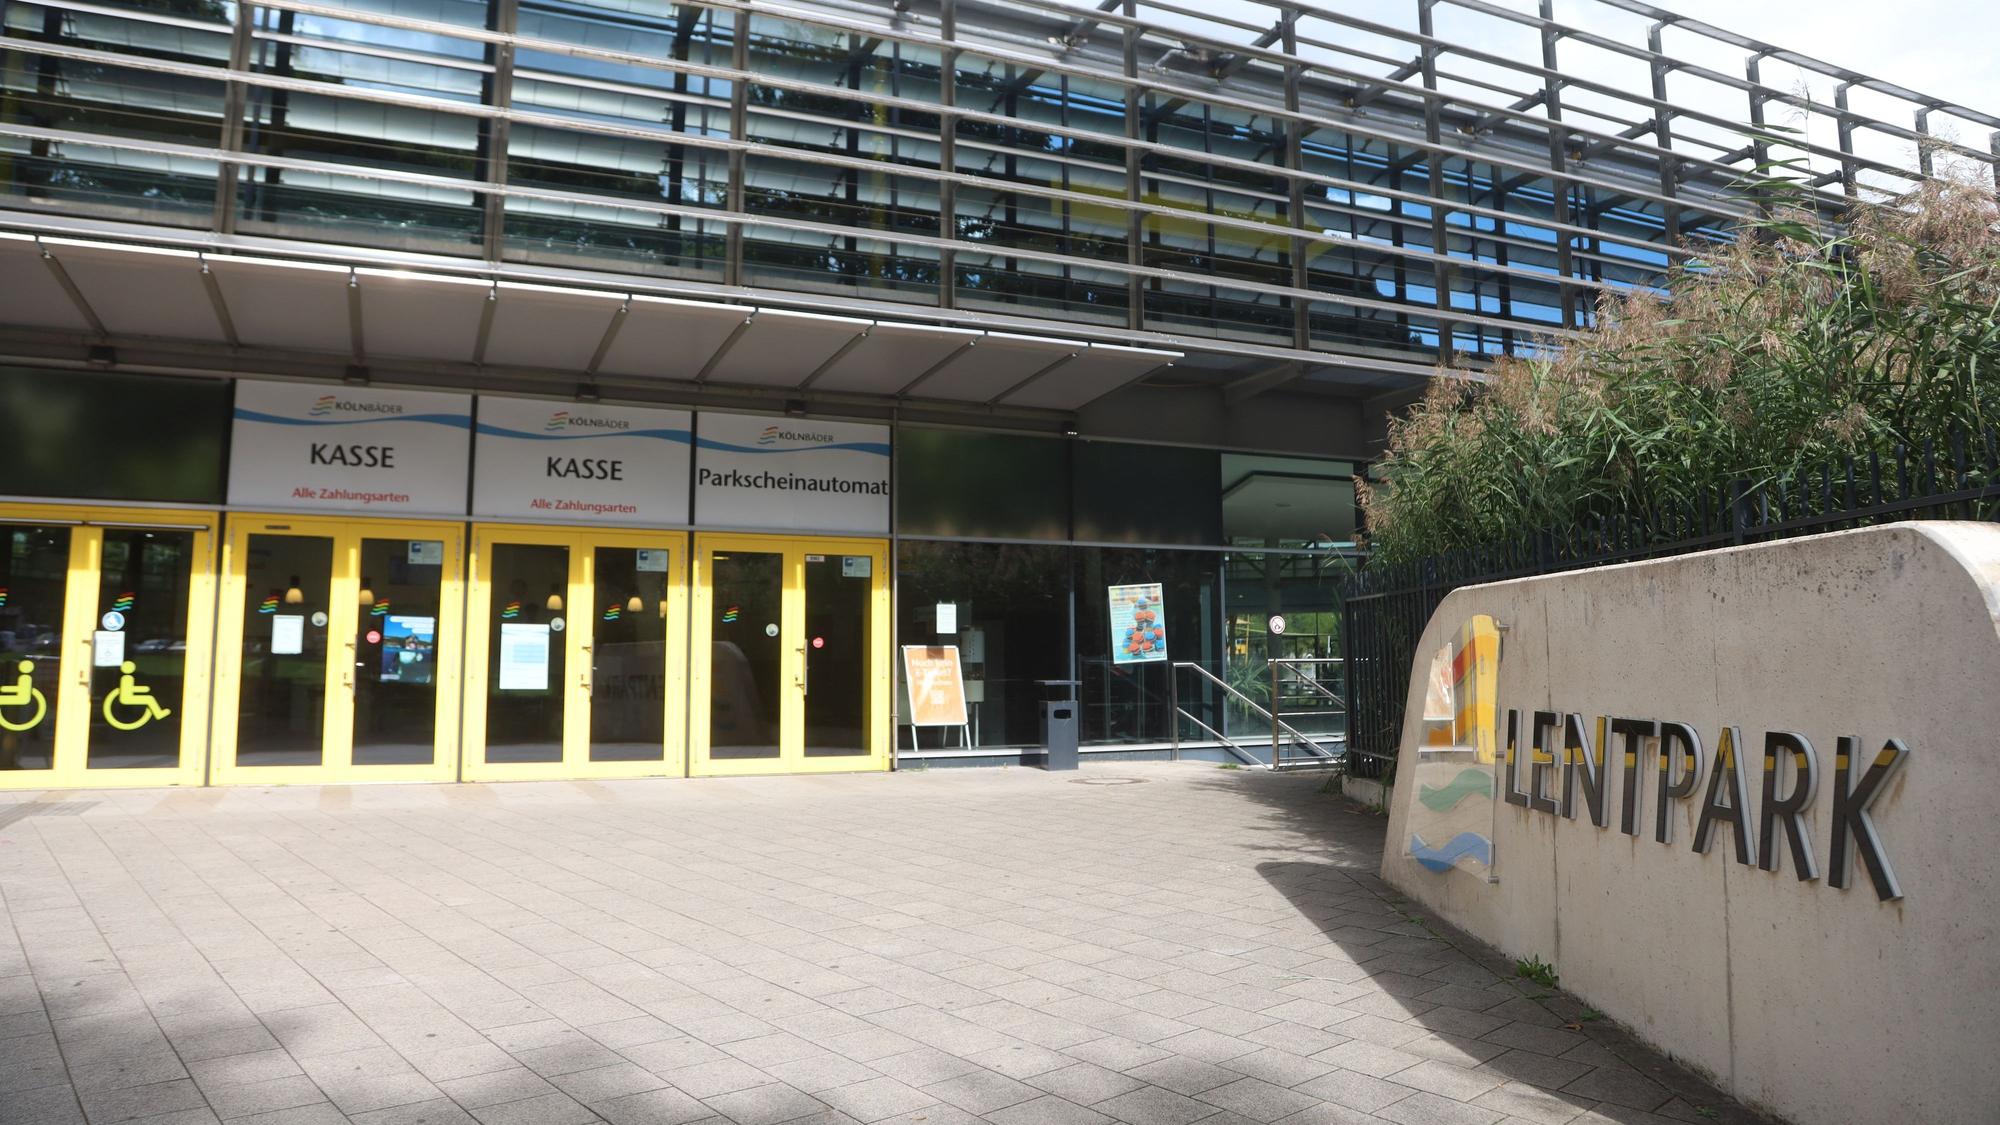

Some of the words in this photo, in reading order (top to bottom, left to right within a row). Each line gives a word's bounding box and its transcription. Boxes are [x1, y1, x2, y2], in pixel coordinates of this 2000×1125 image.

[335, 400, 403, 414] KÖLNBÄDER
[568, 416, 630, 430] KÖLNBÄDER
[778, 430, 834, 443] KÖLNBÄDER
[310, 442, 395, 468] KASSE
[546, 456, 623, 481] KASSE
[698, 467, 888, 495] Parkscheinautomat
[292, 487, 316, 499] Alle
[319, 488, 410, 504] Zahlungsarten
[530, 499, 552, 509] Alle
[555, 500, 637, 514] Zahlungsarten
[1504, 708, 1910, 902] LENTPARK
